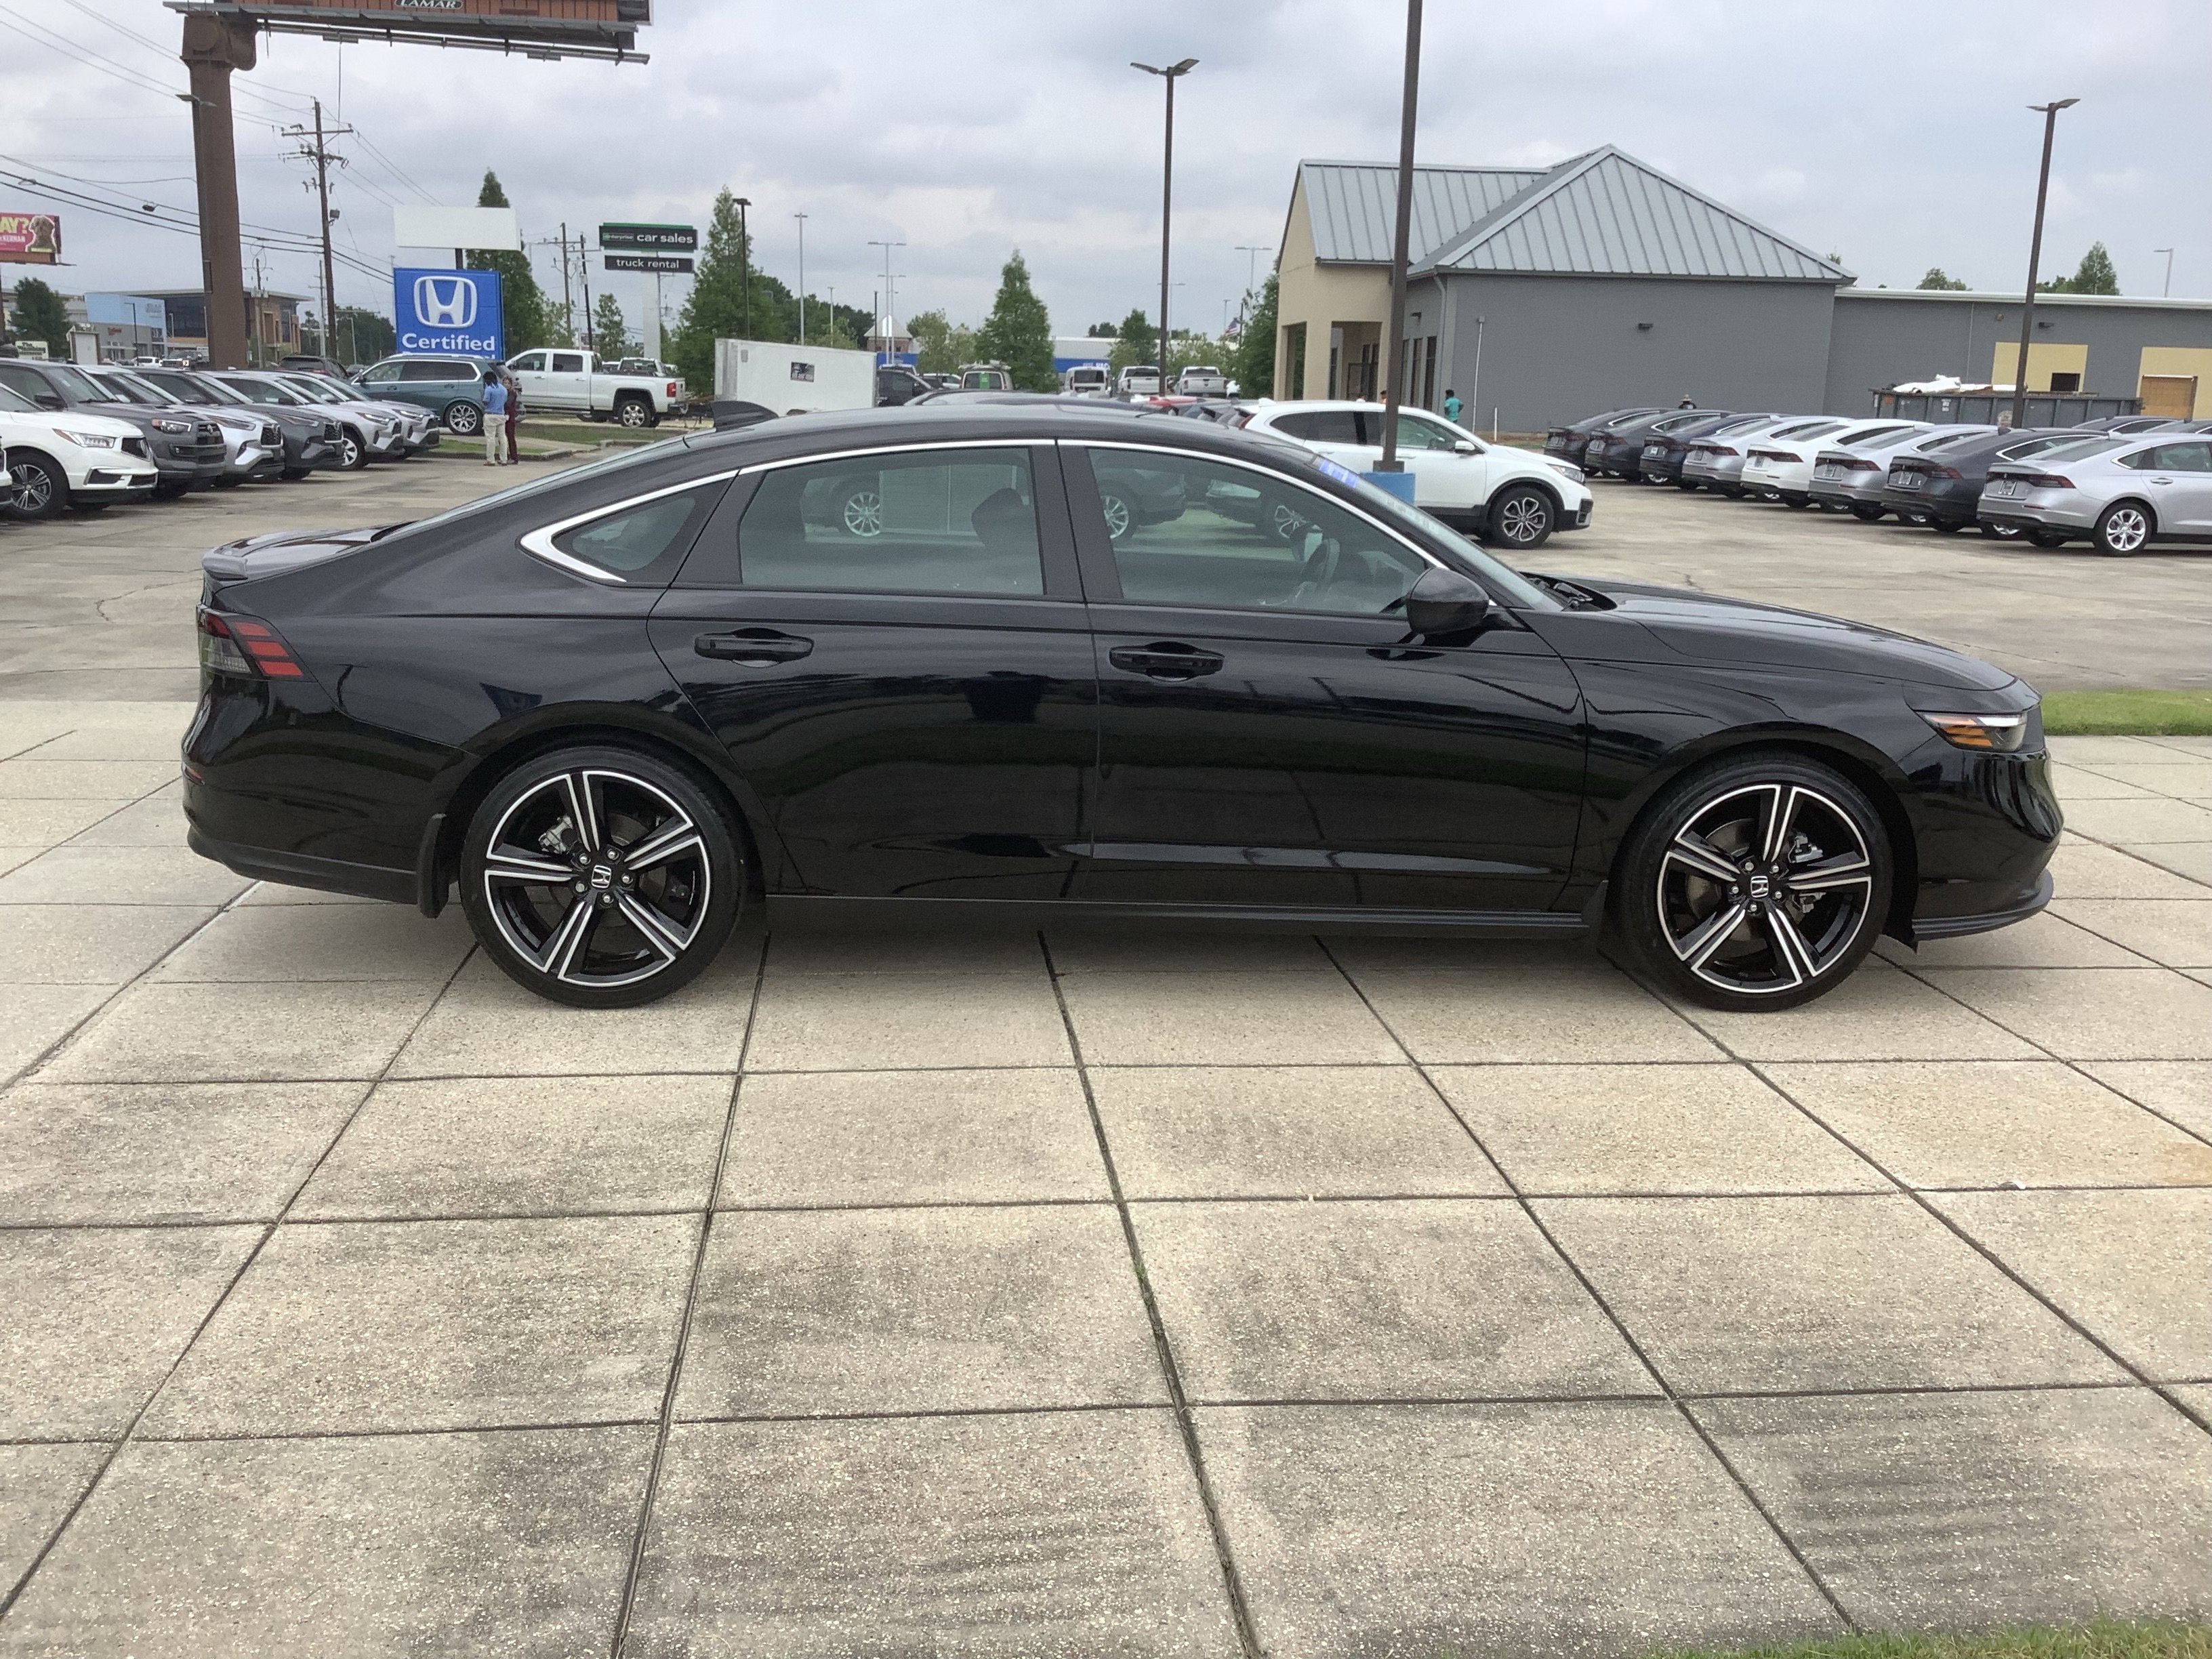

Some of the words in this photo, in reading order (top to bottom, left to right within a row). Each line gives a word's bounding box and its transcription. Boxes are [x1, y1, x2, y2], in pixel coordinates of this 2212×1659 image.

[400, 0, 456, 8] LAMAR
[660, 233, 693, 244] sales
[616, 258, 644, 267] truck
[647, 260, 679, 268] rental
[401, 333, 495, 351] Certified
